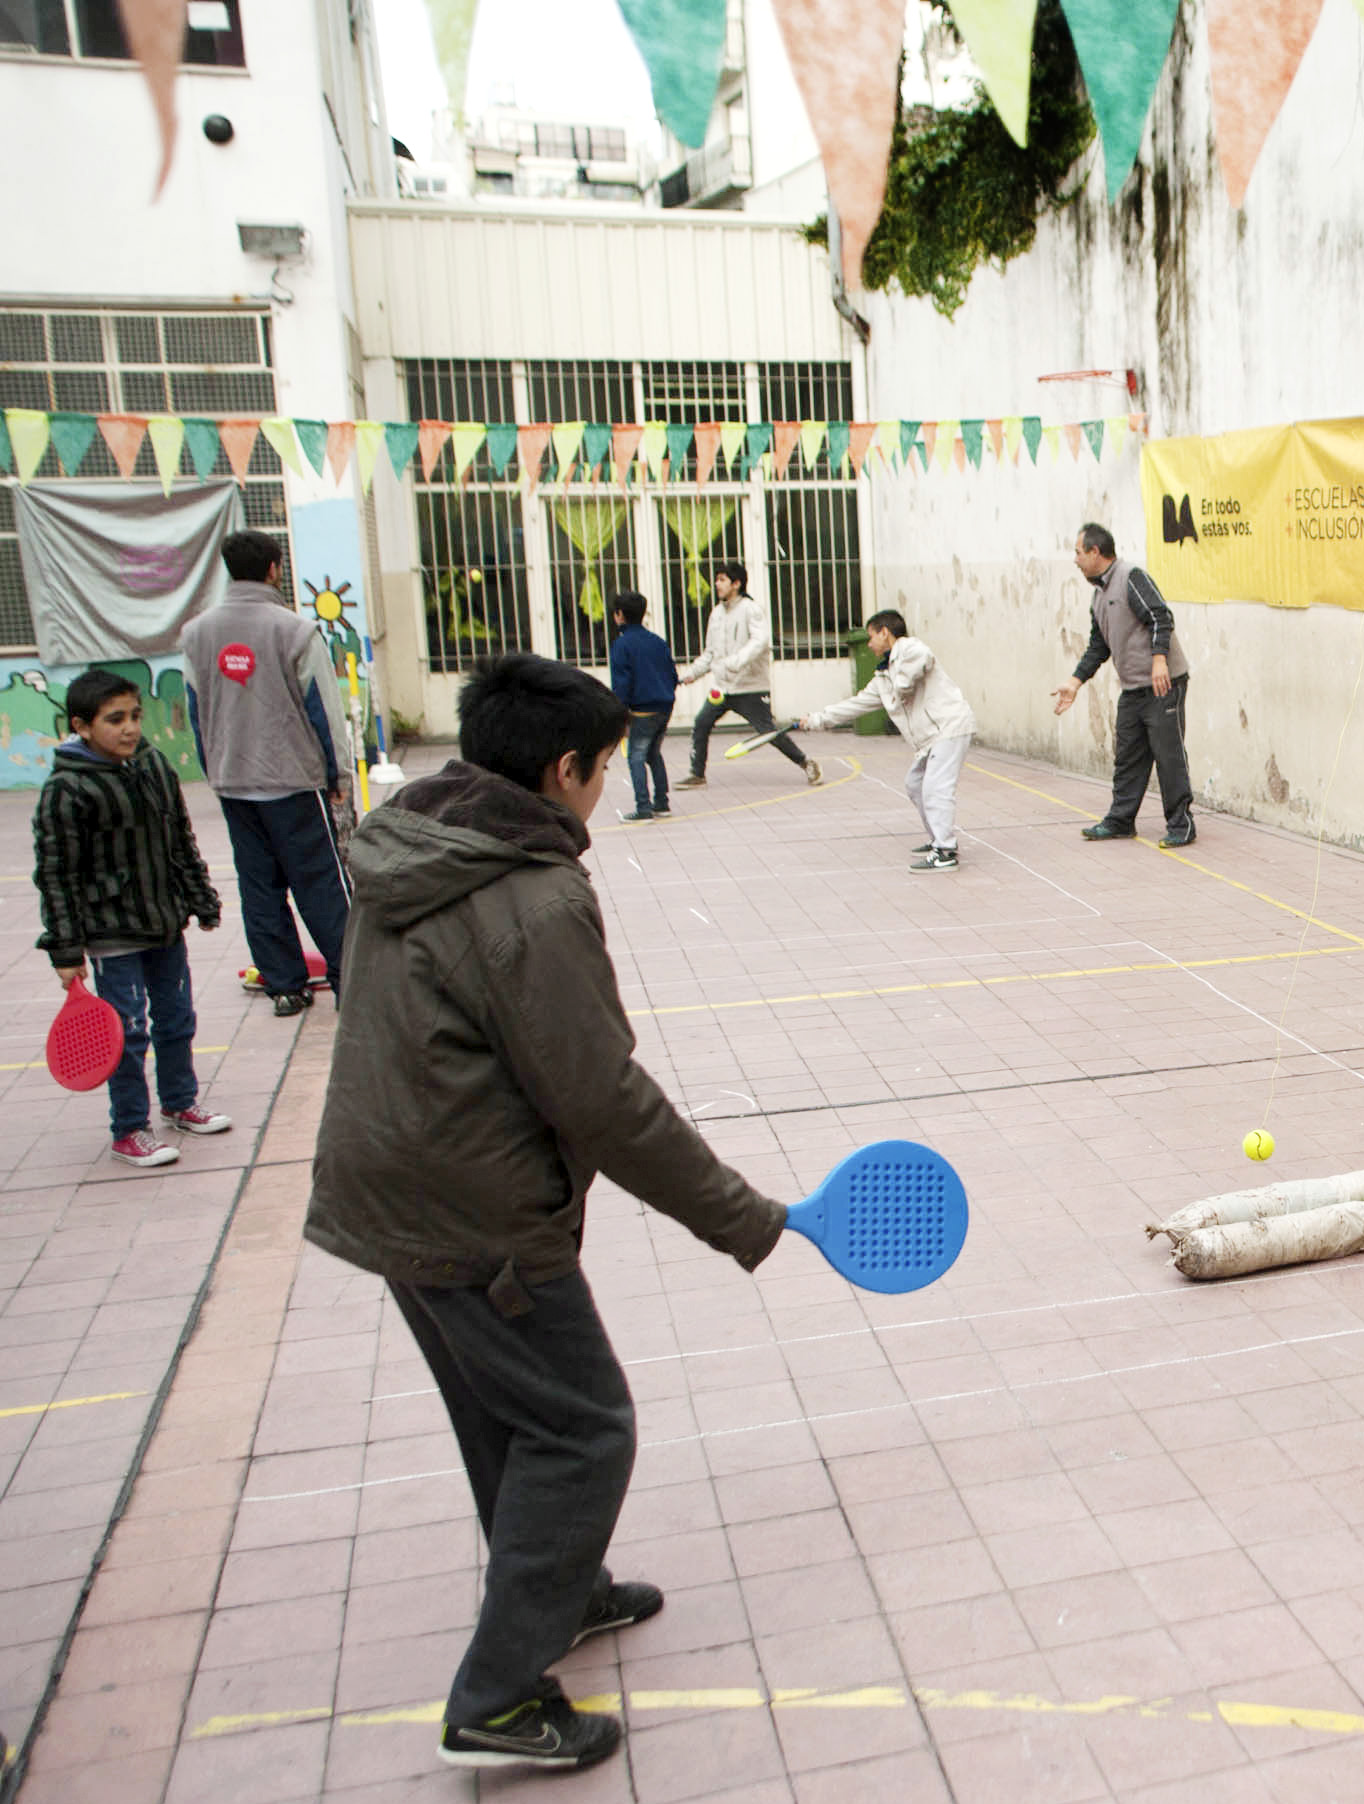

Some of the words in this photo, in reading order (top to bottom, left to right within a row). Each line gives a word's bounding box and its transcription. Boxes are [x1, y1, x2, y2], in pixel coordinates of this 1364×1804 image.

[1201, 498, 1213, 515] En
[1215, 495, 1241, 515] todo
[1202, 519, 1230, 537] estás
[1231, 520, 1253, 537] vos.
